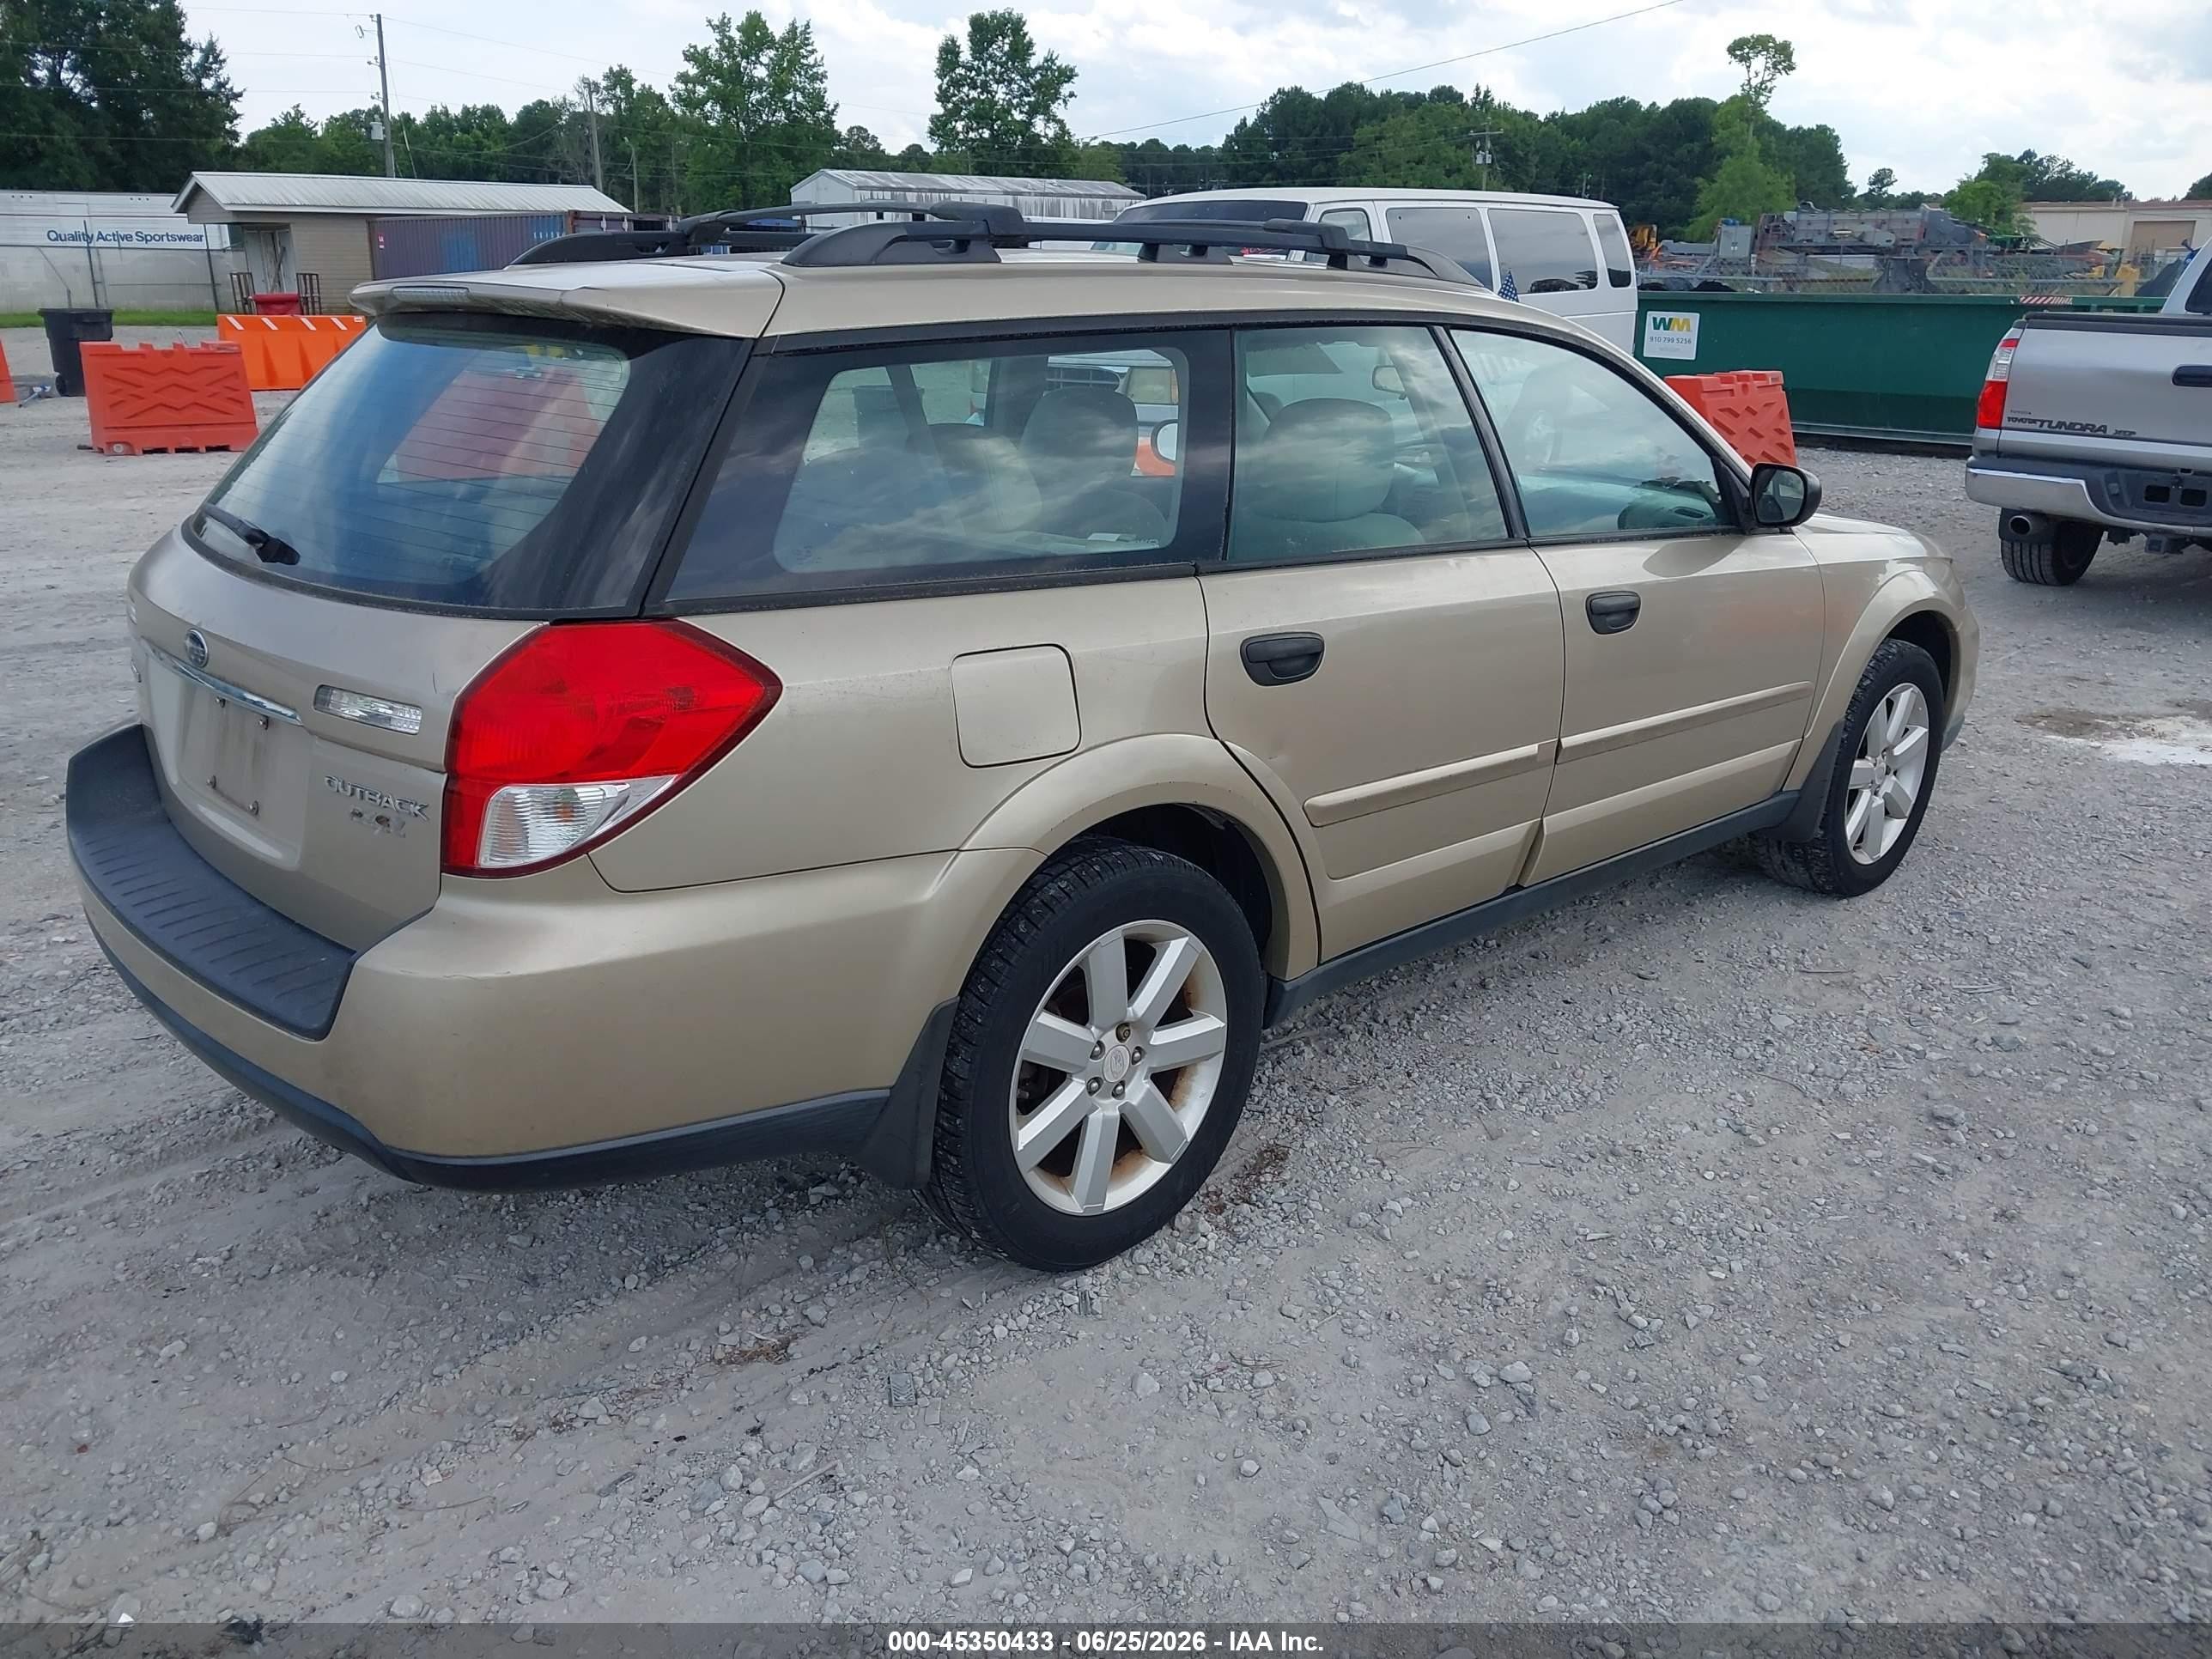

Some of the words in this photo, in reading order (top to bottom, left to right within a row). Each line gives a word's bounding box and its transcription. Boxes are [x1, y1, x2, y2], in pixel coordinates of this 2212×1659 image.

[46, 230, 94, 244] Quality
[135, 231, 204, 244] Sportswear
[1652, 316, 1691, 332] WM
[2037, 419, 2107, 434] TUNDRA
[325, 775, 430, 822] OUTBACK
